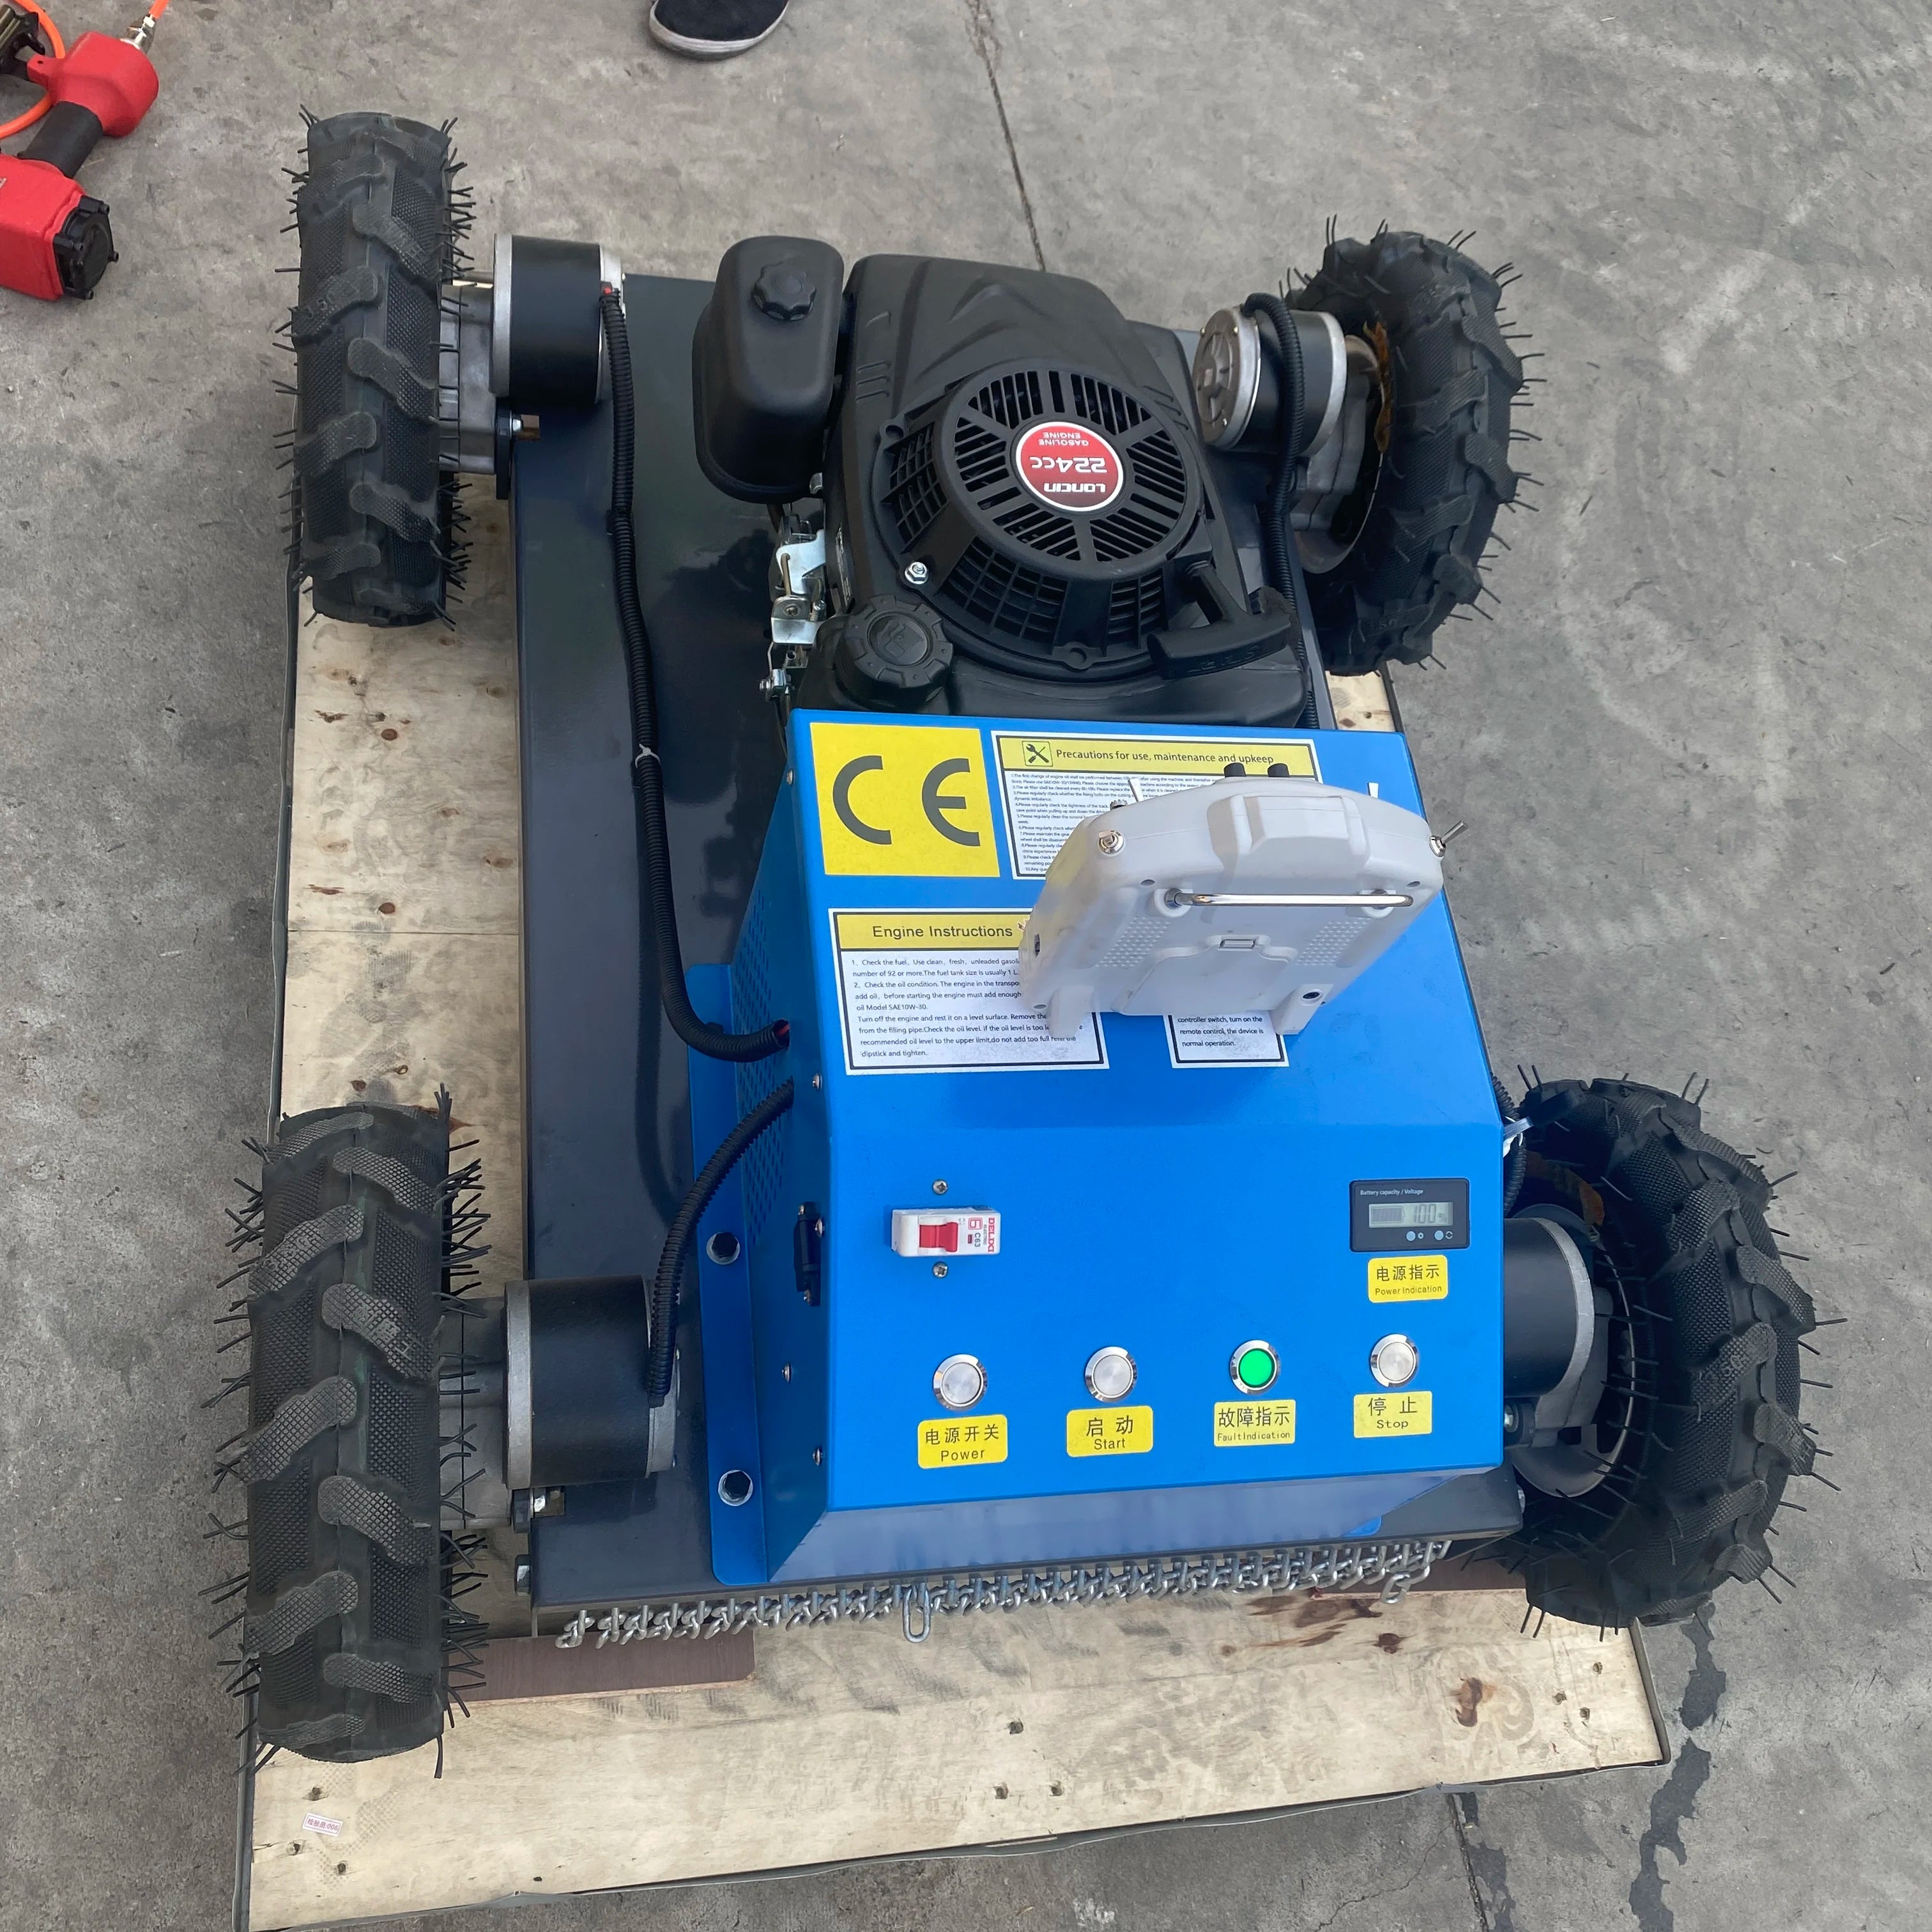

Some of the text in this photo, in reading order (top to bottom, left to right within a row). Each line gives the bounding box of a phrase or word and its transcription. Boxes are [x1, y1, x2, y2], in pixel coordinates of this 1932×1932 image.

[1056, 749, 1114, 759] Precautions
[1116, 751, 1129, 759] for
[1133, 753, 1151, 761] use,
[1154, 753, 1215, 762] maintenance
[1239, 755, 1274, 765] upkeep
[832, 755, 981, 847] CE
[873, 926, 1013, 940] Engine Instructions
[1377, 1264, 1439, 1282] 电源指示
[1375, 1285, 1442, 1296] Power Indication
[1368, 1396, 1418, 1416] 停止
[1218, 1406, 1290, 1428] 故障指示
[1377, 1420, 1408, 1429] Stop
[926, 1424, 999, 1445] 电源开关
[1086, 1415, 1133, 1437] 启动
[1094, 1438, 1126, 1450] Start
[940, 1449, 985, 1462] Power
